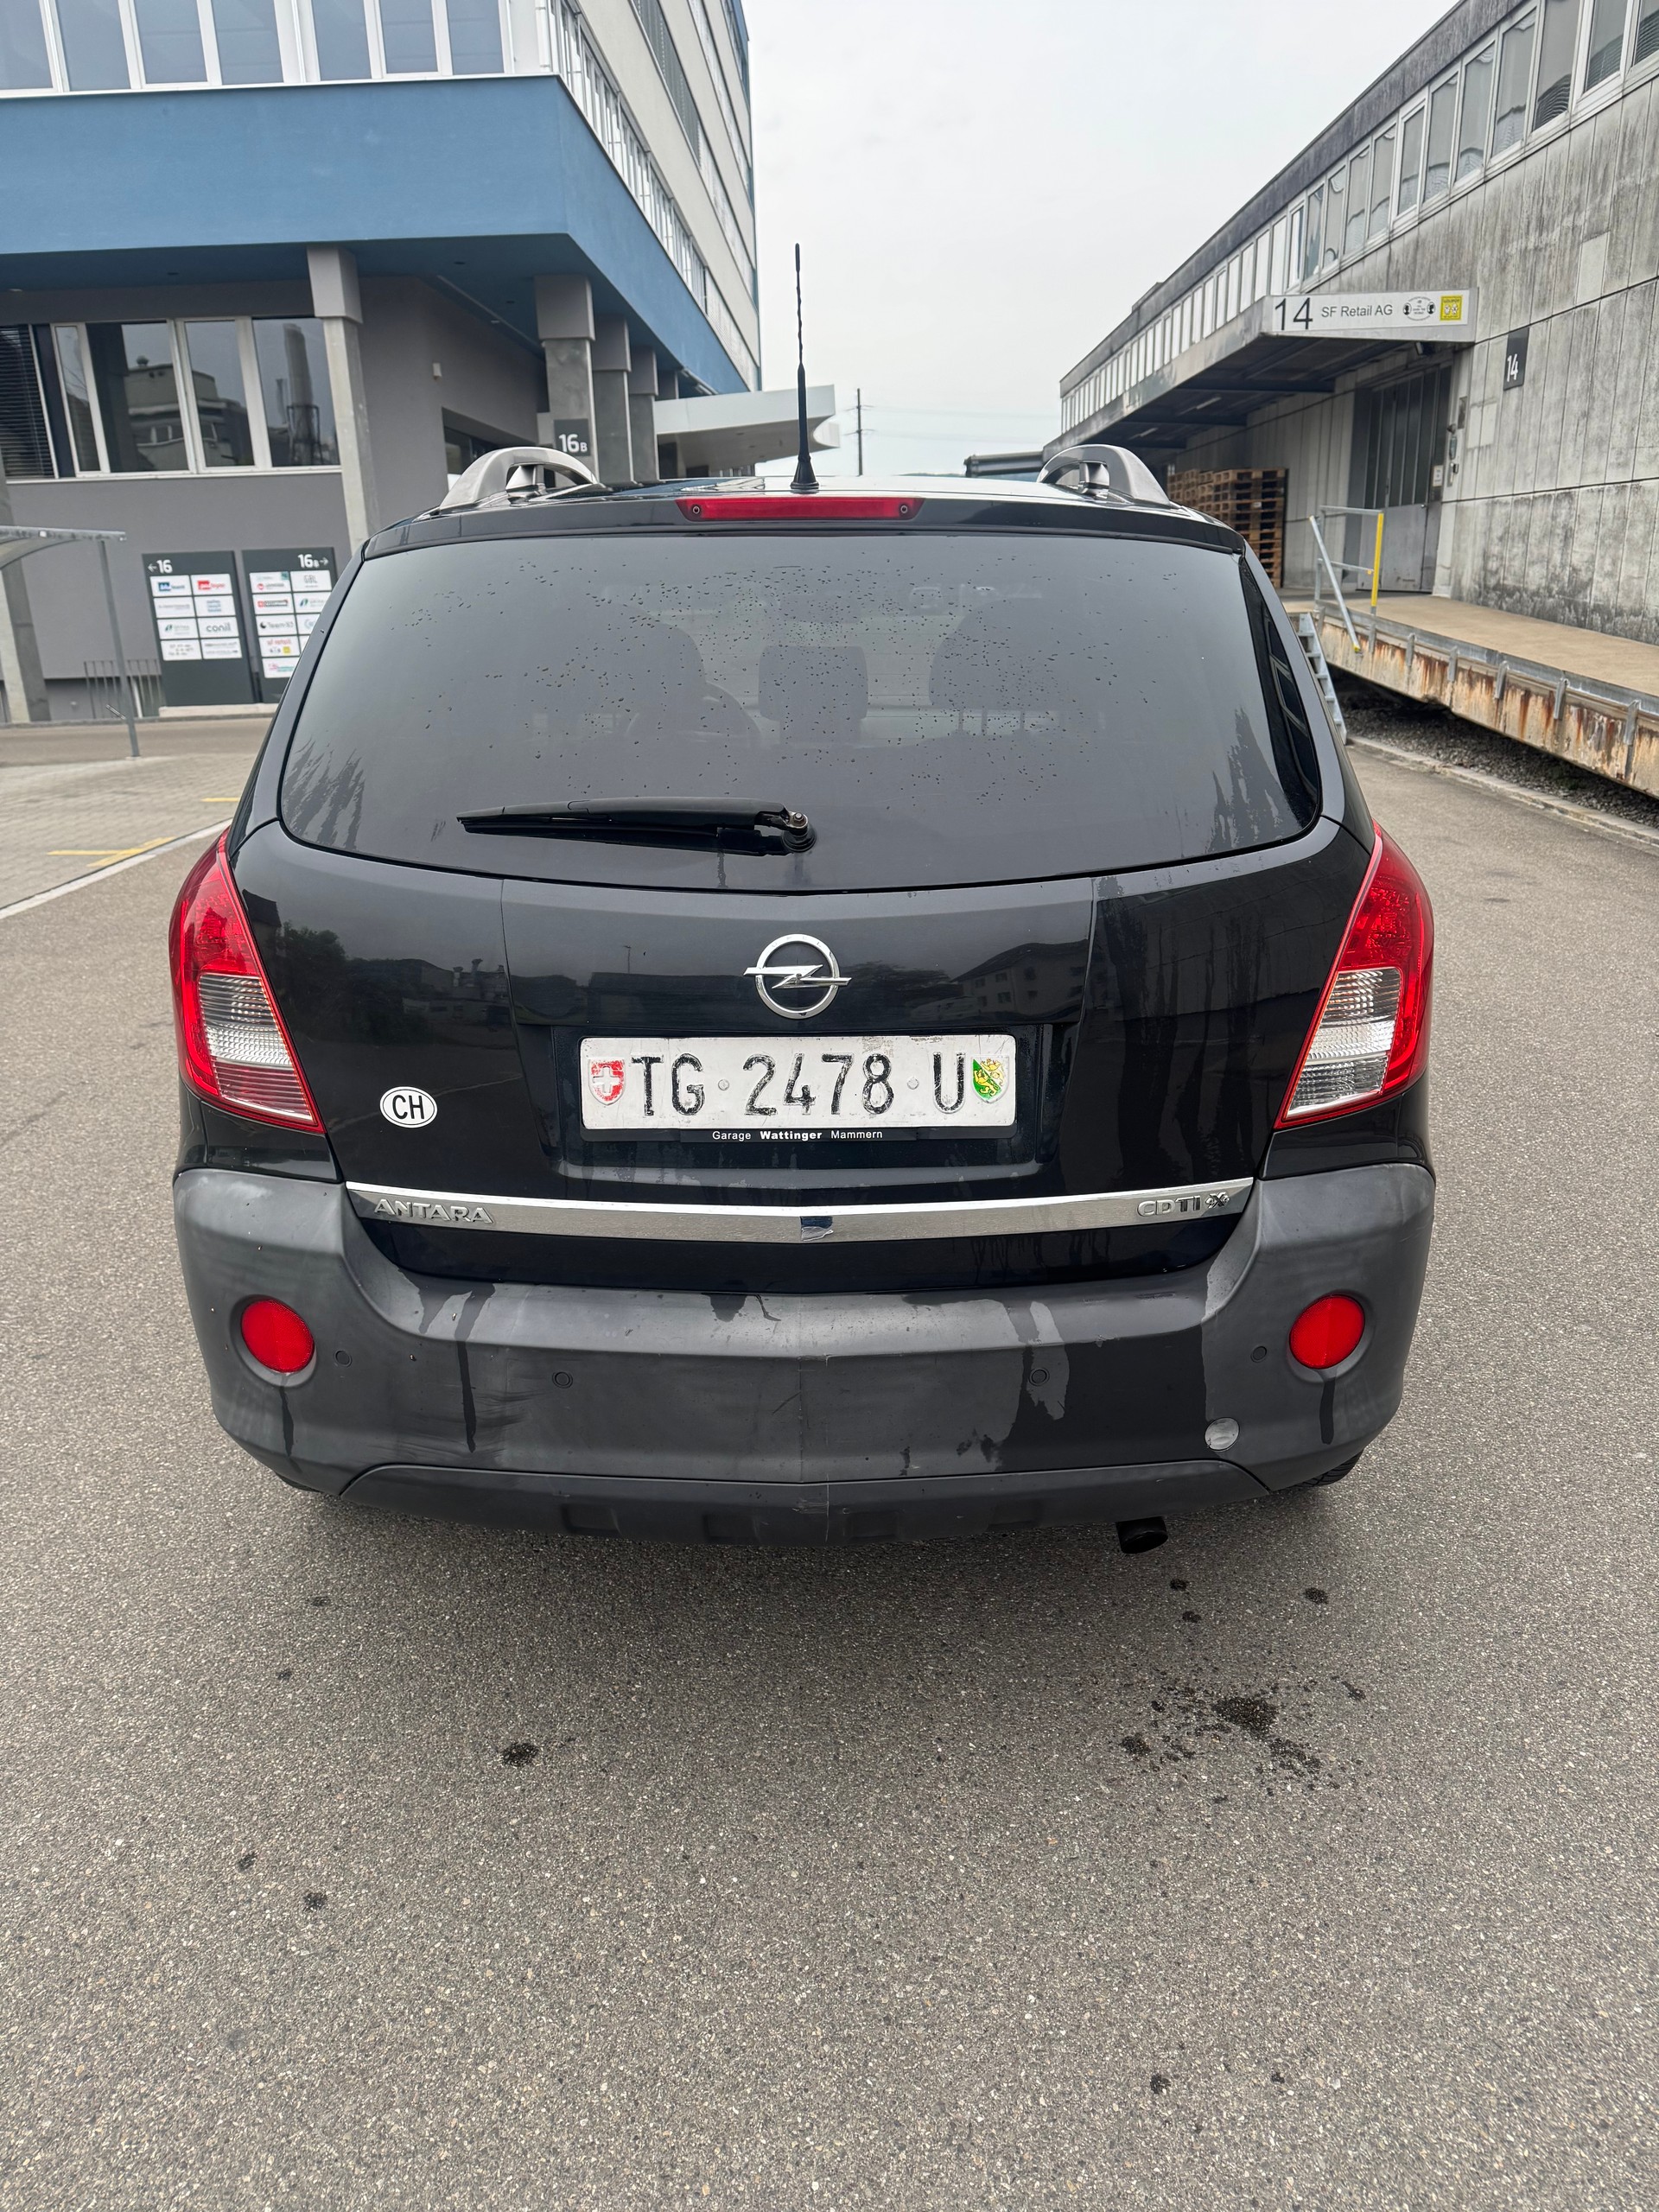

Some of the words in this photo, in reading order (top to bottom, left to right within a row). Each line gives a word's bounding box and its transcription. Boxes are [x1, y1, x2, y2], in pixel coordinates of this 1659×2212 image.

[1274, 297, 1313, 330] 14
[1321, 307, 1338, 318] SF
[1341, 305, 1372, 317] Retail
[1375, 304, 1393, 315] AG
[1507, 353, 1519, 382] 14
[558, 434, 588, 453] 16B
[156, 559, 173, 574] 16
[206, 622, 232, 632] conil
[631, 1052, 705, 1116] TG
[742, 1052, 895, 1116] 2478
[933, 1052, 966, 1115] U
[392, 1094, 425, 1120] CH
[712, 1130, 752, 1141] Garage
[760, 1128, 823, 1141] Wattinger
[830, 1128, 883, 1140] Mammern
[373, 1198, 494, 1224] ANTARA
[1137, 1195, 1201, 1217] CDTI
